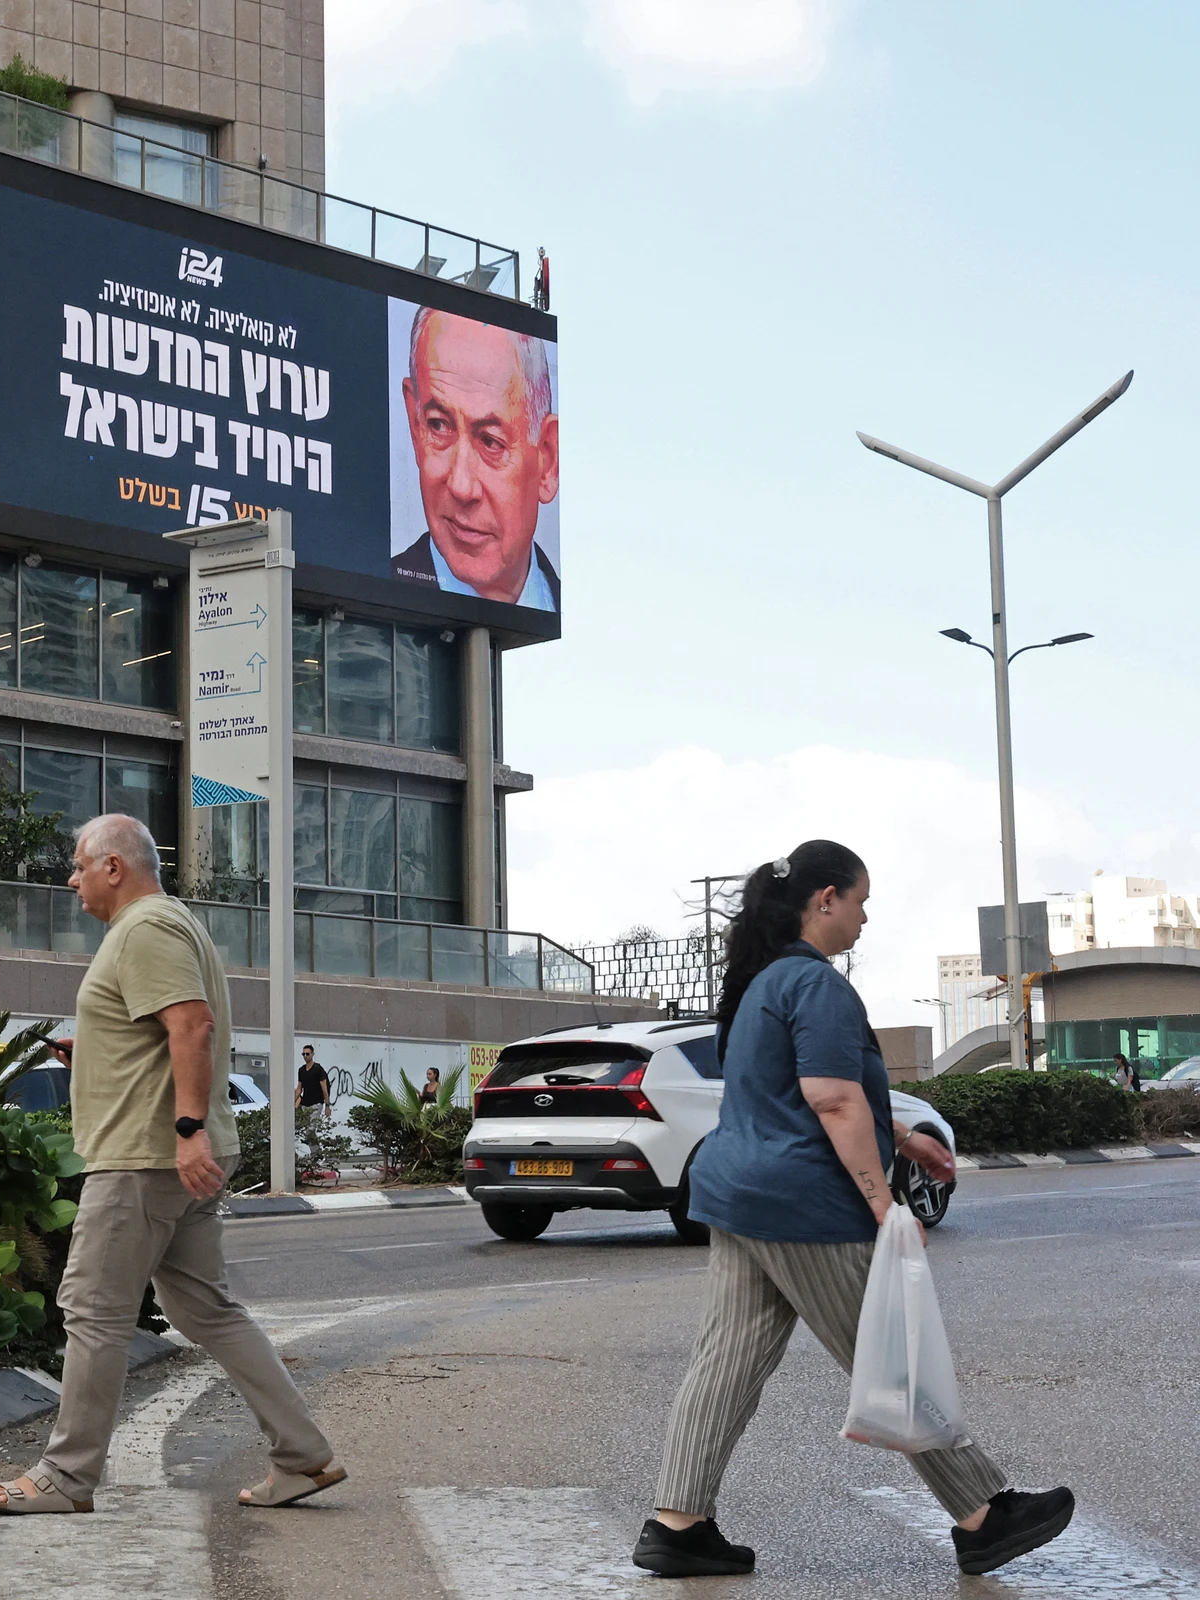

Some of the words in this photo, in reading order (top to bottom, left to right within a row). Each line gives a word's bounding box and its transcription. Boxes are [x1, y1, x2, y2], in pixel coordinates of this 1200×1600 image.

[179, 247, 223, 287] i24
[187, 275, 207, 286] NEWS
[99, 279, 176, 318] אופוזיציה.
[180, 300, 200, 324] לא
[204, 307, 274, 347] קואליציה.
[278, 325, 297, 349] לא
[62, 303, 230, 398] החדשות
[241, 349, 330, 421] ערוץ
[60, 371, 218, 470] בישראל
[228, 420, 332, 494] היחיד
[119, 477, 181, 511] בשלט
[186, 484, 231, 527] 15
[234, 501, 271, 521] רוץ
[199, 591, 227, 608] אילון
[198, 606, 233, 621] Ayalon
[199, 669, 224, 682] נמיר
[199, 682, 229, 696] Namir
[199, 718, 227, 730] לשלום
[230, 716, 255, 727] צאתך
[234, 725, 268, 737] ממתחם
[199, 729, 232, 741] הבורסה
[471, 1047, 503, 1067] 053-85
